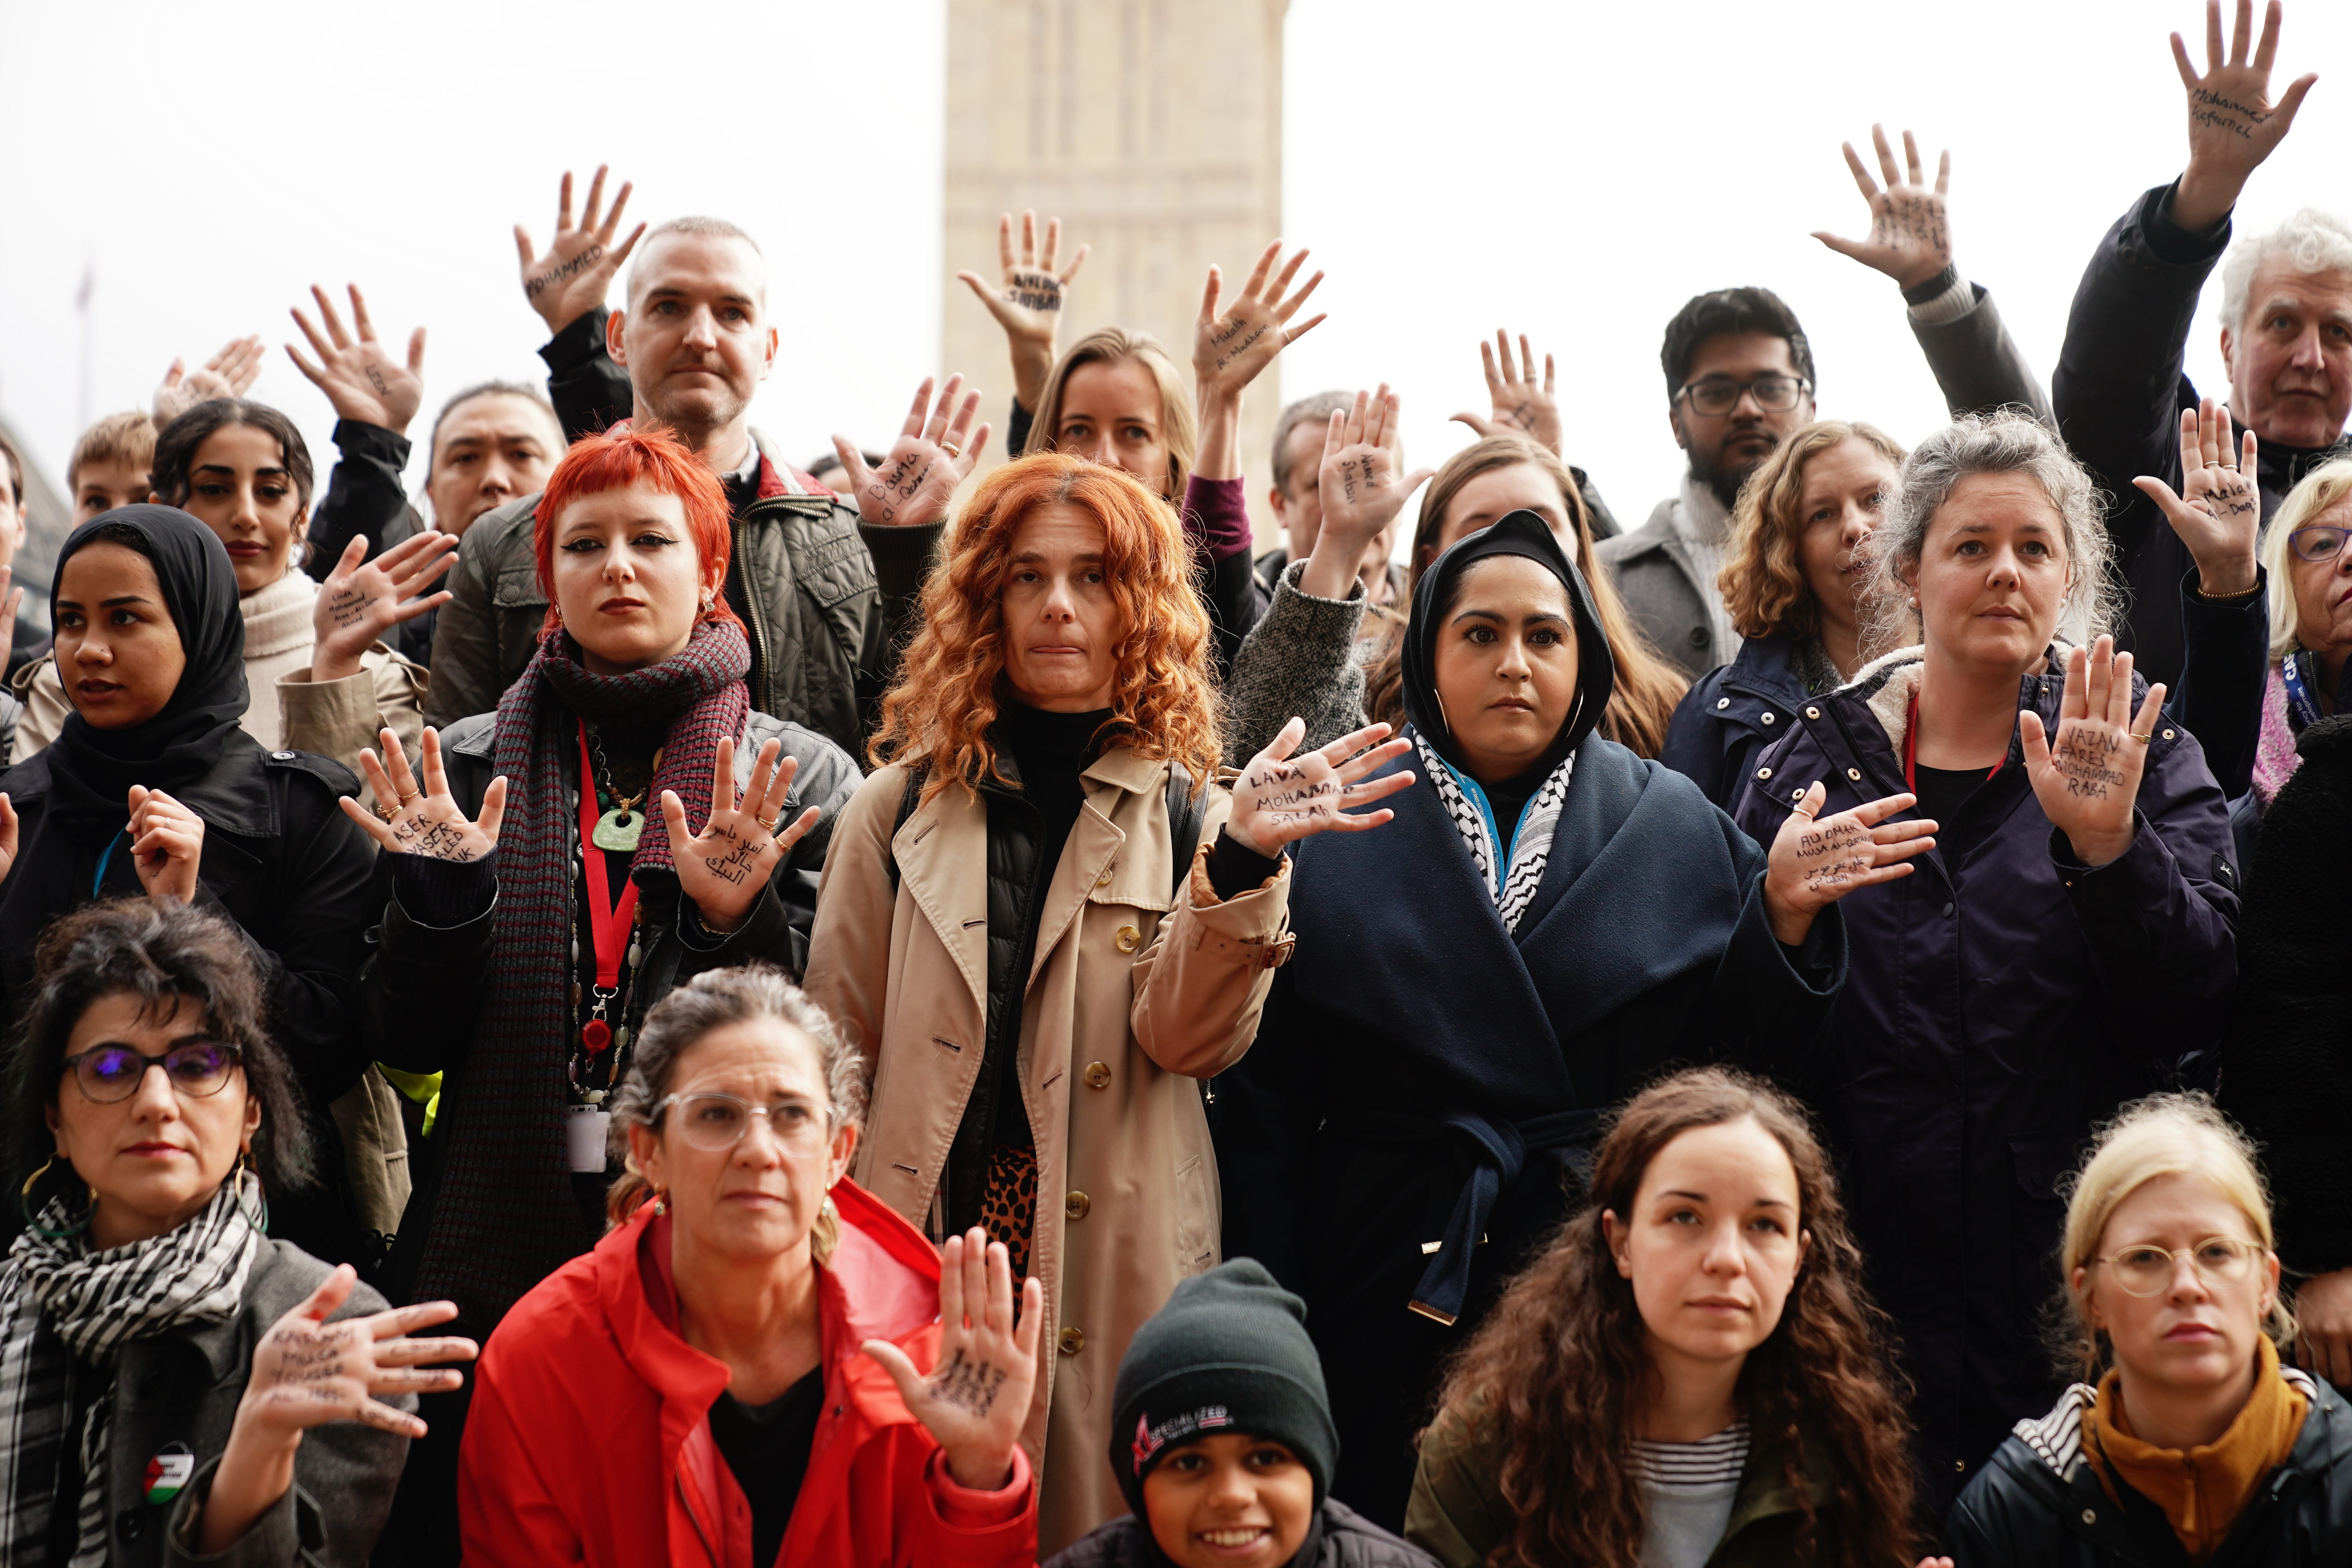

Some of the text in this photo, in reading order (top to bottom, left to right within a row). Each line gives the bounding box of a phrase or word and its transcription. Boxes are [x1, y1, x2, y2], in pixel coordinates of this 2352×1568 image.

[526, 245, 602, 299] MOHAMMED
[1210, 318, 1247, 347] Muath
[366, 364, 392, 396] LEEN
[332, 590, 352, 601] Linda
[2066, 726, 2120, 753] YAZAN
[2060, 746, 2105, 767] FARES
[1250, 767, 1306, 788] LAVA
[393, 814, 432, 844] ASER
[407, 822, 452, 855] YASER
[708, 824, 736, 843] ياسر
[1826, 823, 1861, 839] OMAR
[725, 851, 751, 873] خالد
